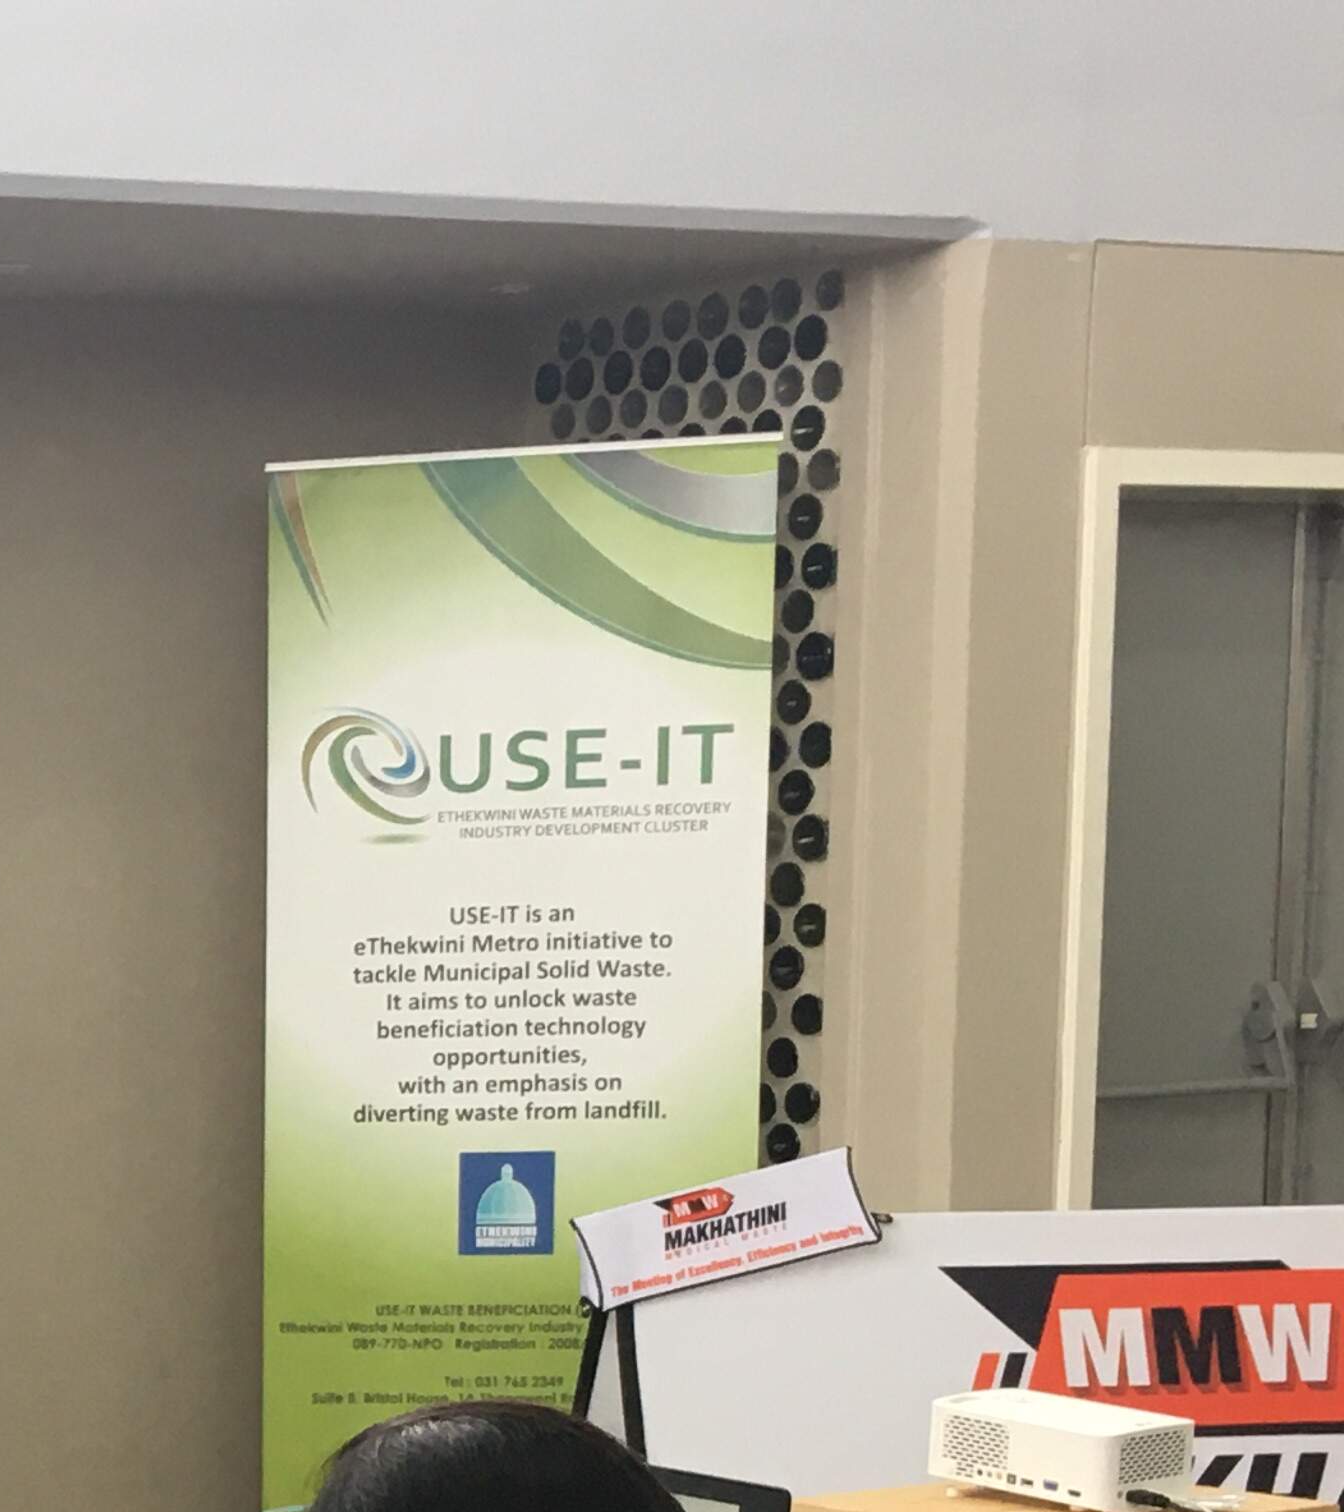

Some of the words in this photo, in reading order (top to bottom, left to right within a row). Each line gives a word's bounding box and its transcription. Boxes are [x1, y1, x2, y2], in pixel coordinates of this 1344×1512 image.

[439, 723, 734, 794] USE-IT
[438, 809, 516, 823] ETHEKWINI
[519, 807, 567, 820] WASTE
[571, 804, 651, 818] MATERIALS
[655, 802, 731, 816] RECOVERY
[459, 825, 532, 838] INDUSTRY
[535, 821, 641, 836] DEVELOPMENT
[644, 819, 709, 833] CLUSTER
[450, 905, 519, 925] USE-IT
[526, 904, 542, 923] is
[548, 907, 574, 922] an
[354, 935, 464, 956] eThekwini
[472, 935, 539, 952] Metro
[546, 931, 642, 950] initiative
[650, 932, 672, 948] to
[353, 964, 416, 984] tackle
[424, 961, 530, 985] Municipal
[537, 960, 589, 979] Solid
[597, 960, 671, 978] Waste.
[387, 994, 401, 1011] It
[408, 992, 458, 1010] aims
[465, 993, 487, 1009] to
[494, 988, 566, 1008] unlock
[572, 989, 637, 1006] waste
[377, 1019, 518, 1039] beneficiation
[525, 1016, 646, 1039] technology
[433, 1045, 587, 1070] opportunities,
[398, 1075, 445, 1094] with
[452, 1080, 478, 1094] an
[486, 1073, 588, 1096] emphasis
[595, 1077, 622, 1091] on
[353, 1104, 449, 1126] diverting
[455, 1105, 518, 1121] waste
[525, 1101, 577, 1120] from
[585, 1100, 666, 1119] landfill.
[665, 1202, 786, 1251] MAKHATHINI
[419, 1304, 462, 1317] WASTE
[468, 1304, 572, 1317] BENEFICIATION
[346, 1322, 388, 1333] Waste
[459, 1321, 525, 1335] Recovery
[1059, 1303, 1333, 1388] MMW
